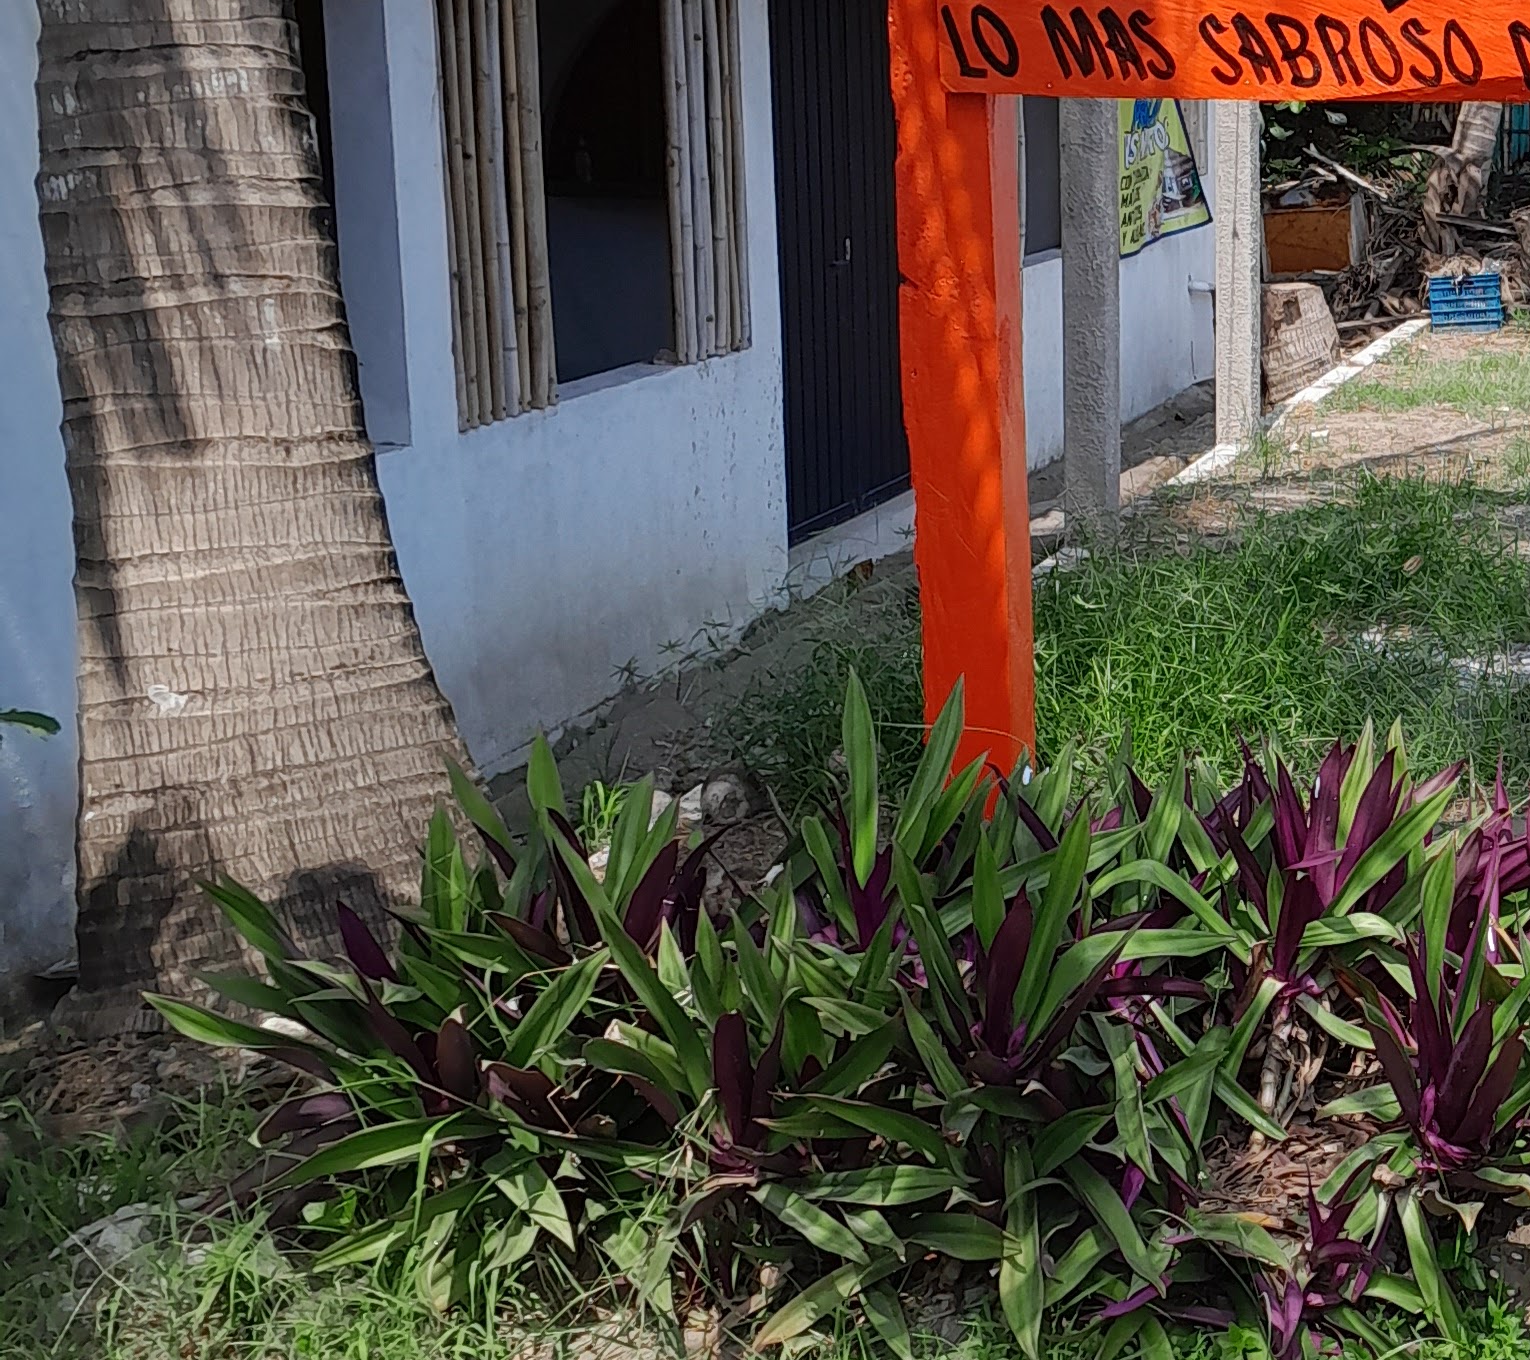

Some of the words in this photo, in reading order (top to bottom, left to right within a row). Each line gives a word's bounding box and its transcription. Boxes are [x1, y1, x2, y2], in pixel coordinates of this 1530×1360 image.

[941, 5, 1020, 78] LO
[1041, 6, 1175, 81] MAS
[1199, 14, 1483, 86] SABROSO
